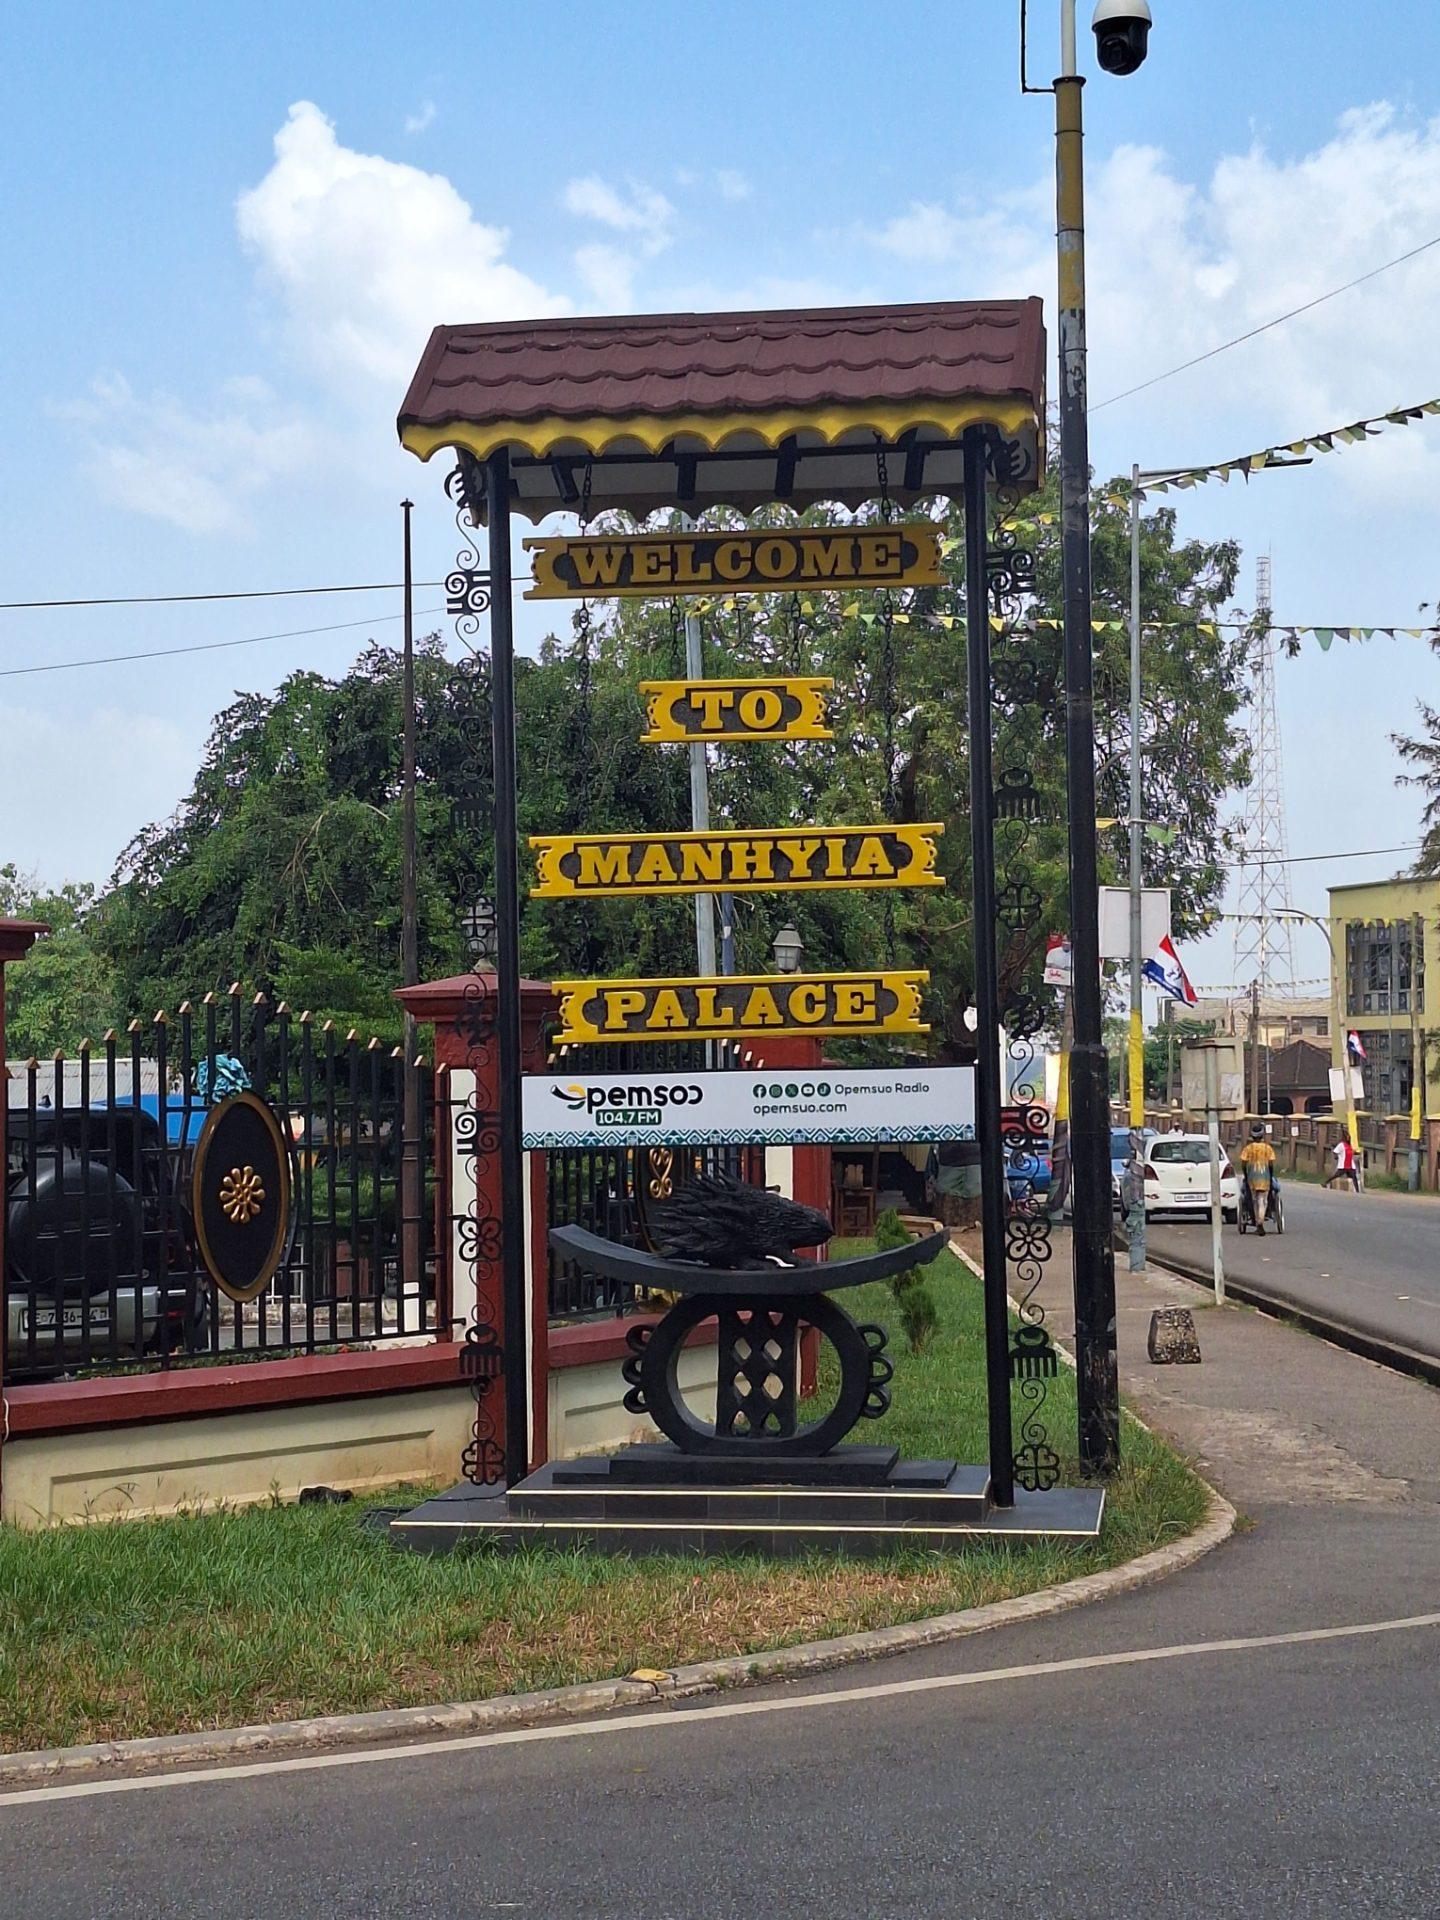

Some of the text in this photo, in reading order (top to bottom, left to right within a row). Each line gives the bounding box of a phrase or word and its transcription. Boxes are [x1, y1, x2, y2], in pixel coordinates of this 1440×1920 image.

[569, 537, 901, 584] WELCOME
[690, 690, 783, 730] TO
[576, 837, 895, 883] MANHYIA
[604, 983, 877, 1029] PALACE
[834, 1082, 930, 1096] Opemsuo Radio
[599, 1111, 659, 1124] 104.7 FM
[753, 1103, 847, 1116] opemsuo.com
